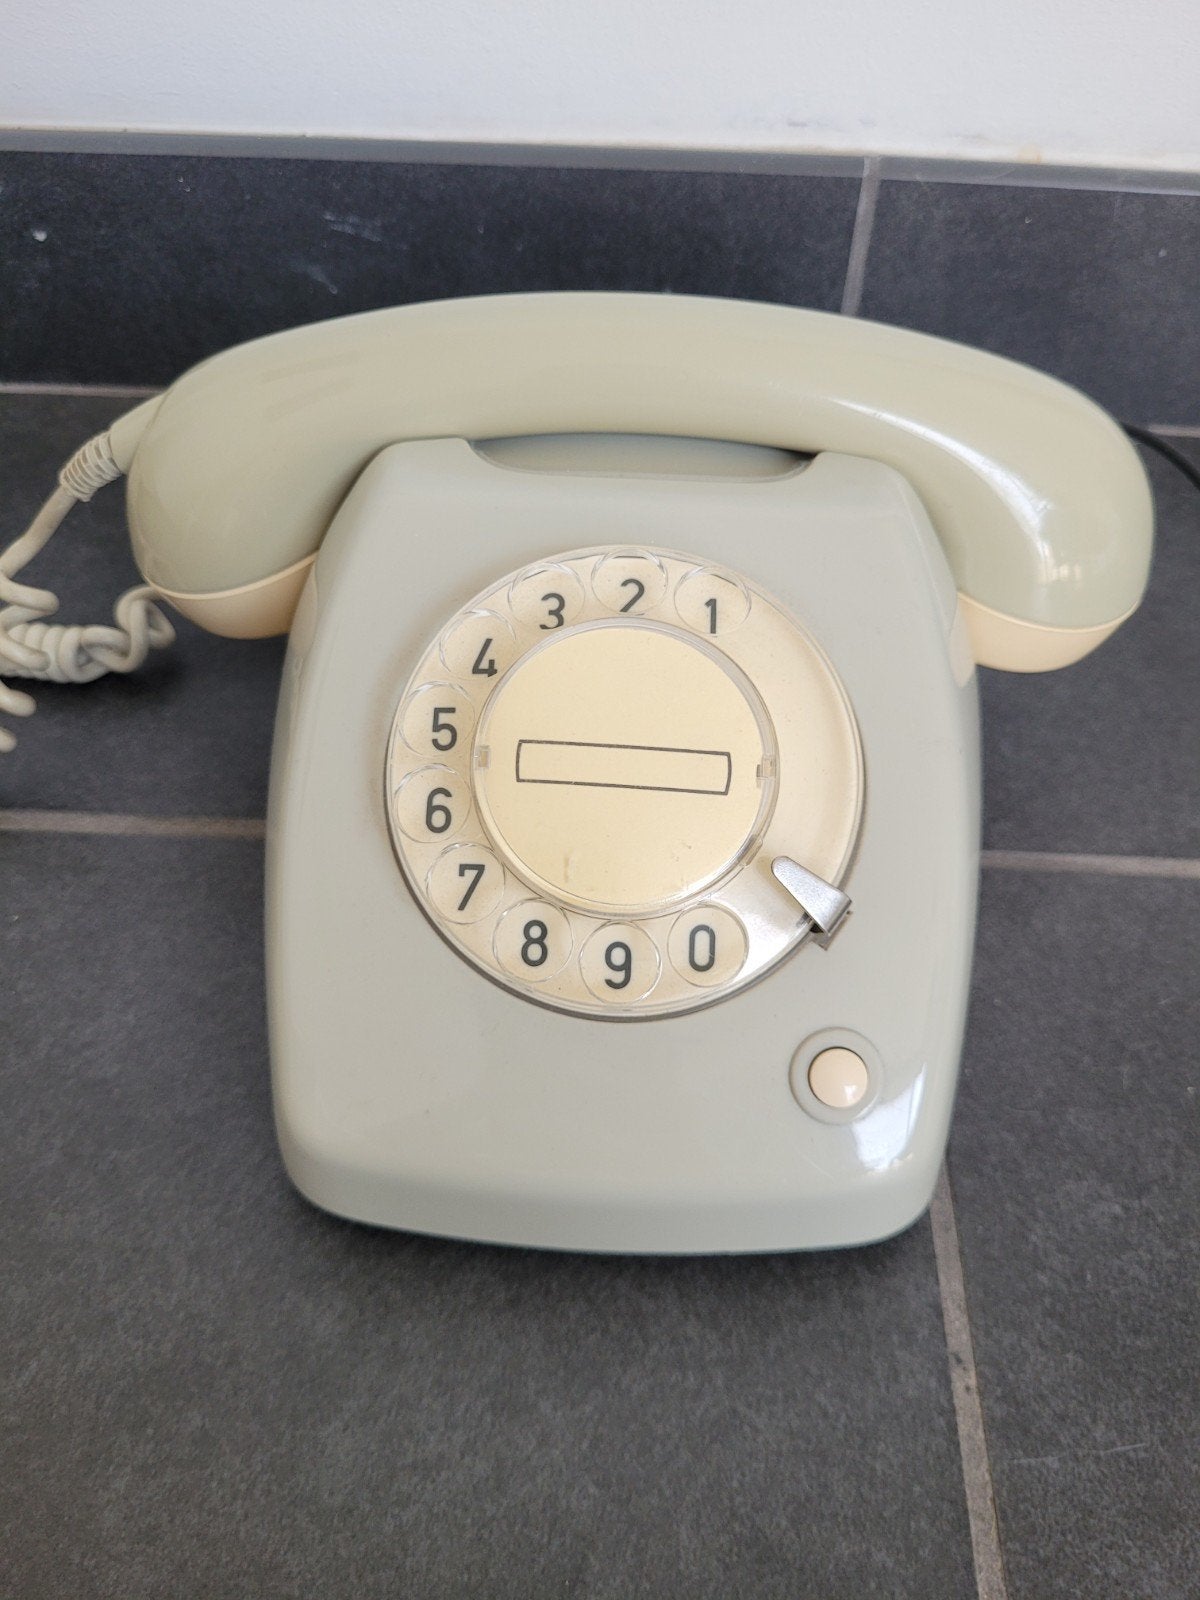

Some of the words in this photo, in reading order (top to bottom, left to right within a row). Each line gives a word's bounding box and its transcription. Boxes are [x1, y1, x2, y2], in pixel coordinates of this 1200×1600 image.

[539, 592, 566, 630] 3
[619, 578, 645, 614] 2
[704, 598, 718, 635] 1
[471, 638, 498, 678] 4
[431, 706, 458, 752] 5
[425, 787, 453, 834] 6
[457, 863, 486, 912] 7
[520, 919, 549, 968] 8
[604, 941, 632, 990] 9
[688, 924, 716, 973] 0
